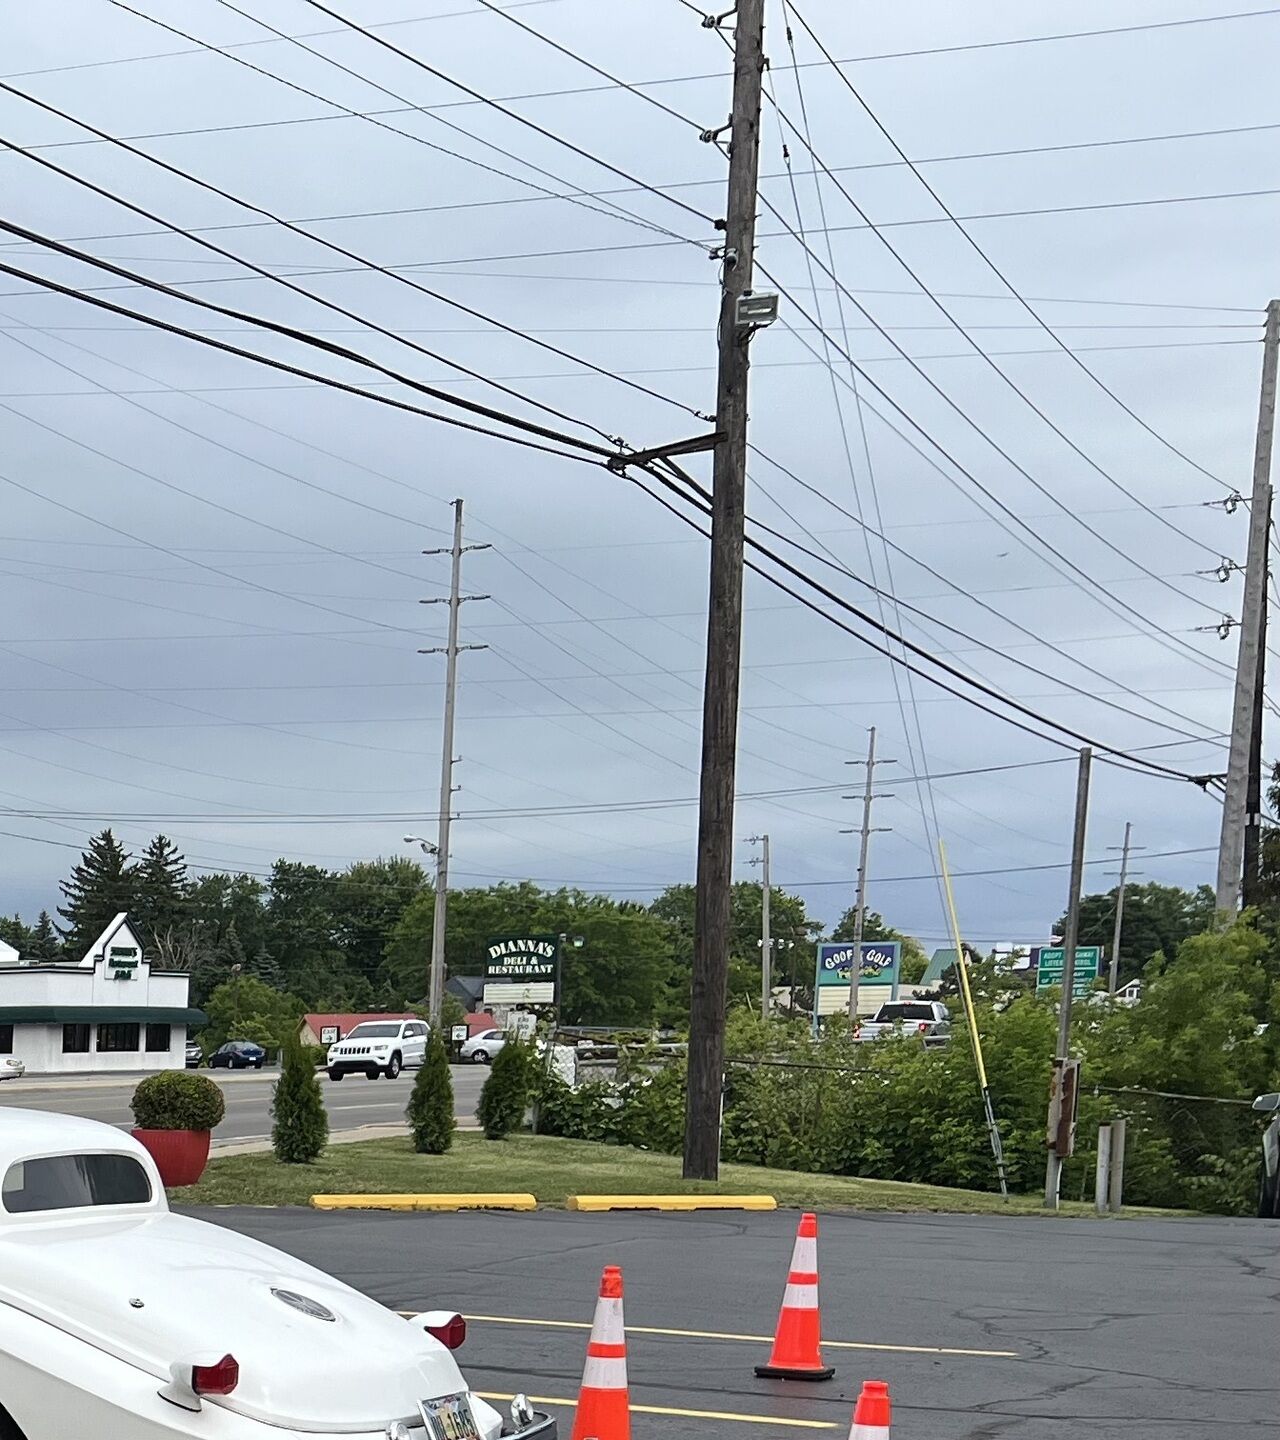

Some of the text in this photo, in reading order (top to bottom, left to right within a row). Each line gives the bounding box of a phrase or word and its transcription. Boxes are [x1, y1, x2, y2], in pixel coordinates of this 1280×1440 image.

[488, 939, 555, 959] DIANNA'S
[488, 964, 554, 975] RESTAURANT
[503, 955, 538, 965] DELI &
[825, 949, 892, 970] GOOF GOLF
[447, 1408, 476, 1440] 1685
